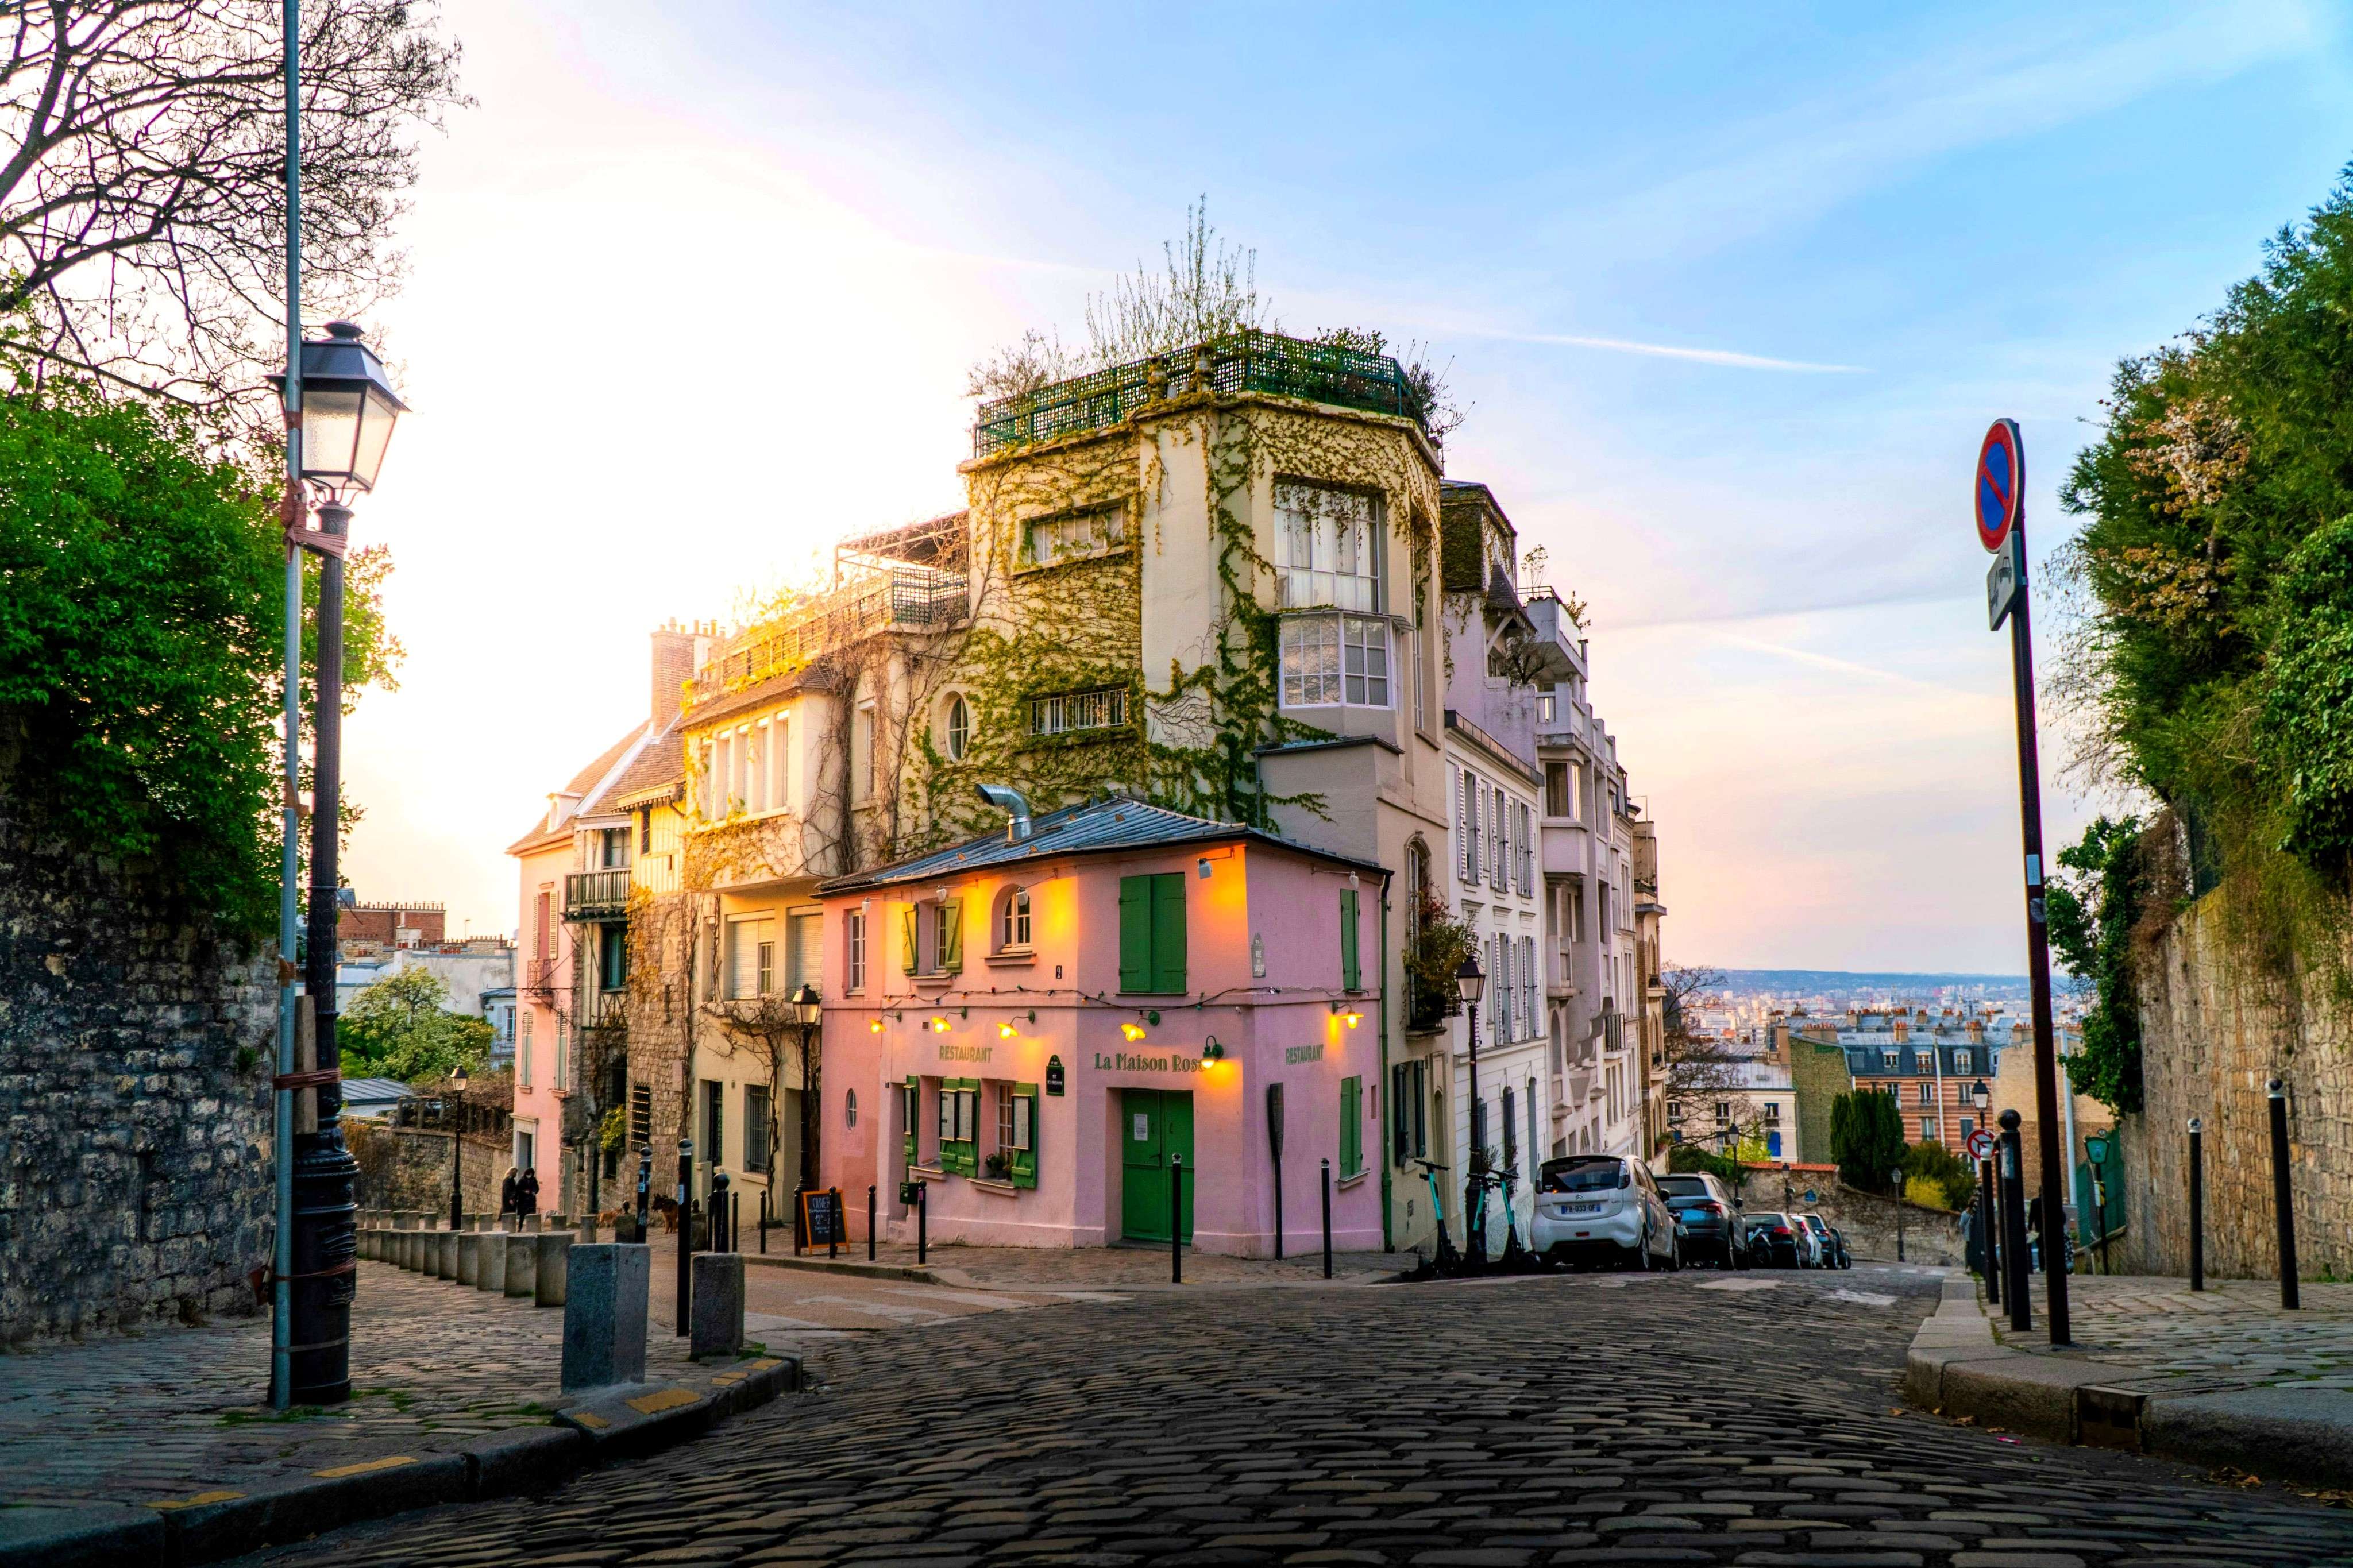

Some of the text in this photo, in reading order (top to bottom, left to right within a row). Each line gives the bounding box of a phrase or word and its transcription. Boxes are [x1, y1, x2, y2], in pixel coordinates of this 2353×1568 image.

[939, 1045, 993, 1064] RESTAURANT
[1094, 1052, 1112, 1071] La
[1116, 1053, 1168, 1072] Maison
[1286, 1044, 1324, 1065] RESTAURANT
[812, 1197, 830, 1210] OUVER
